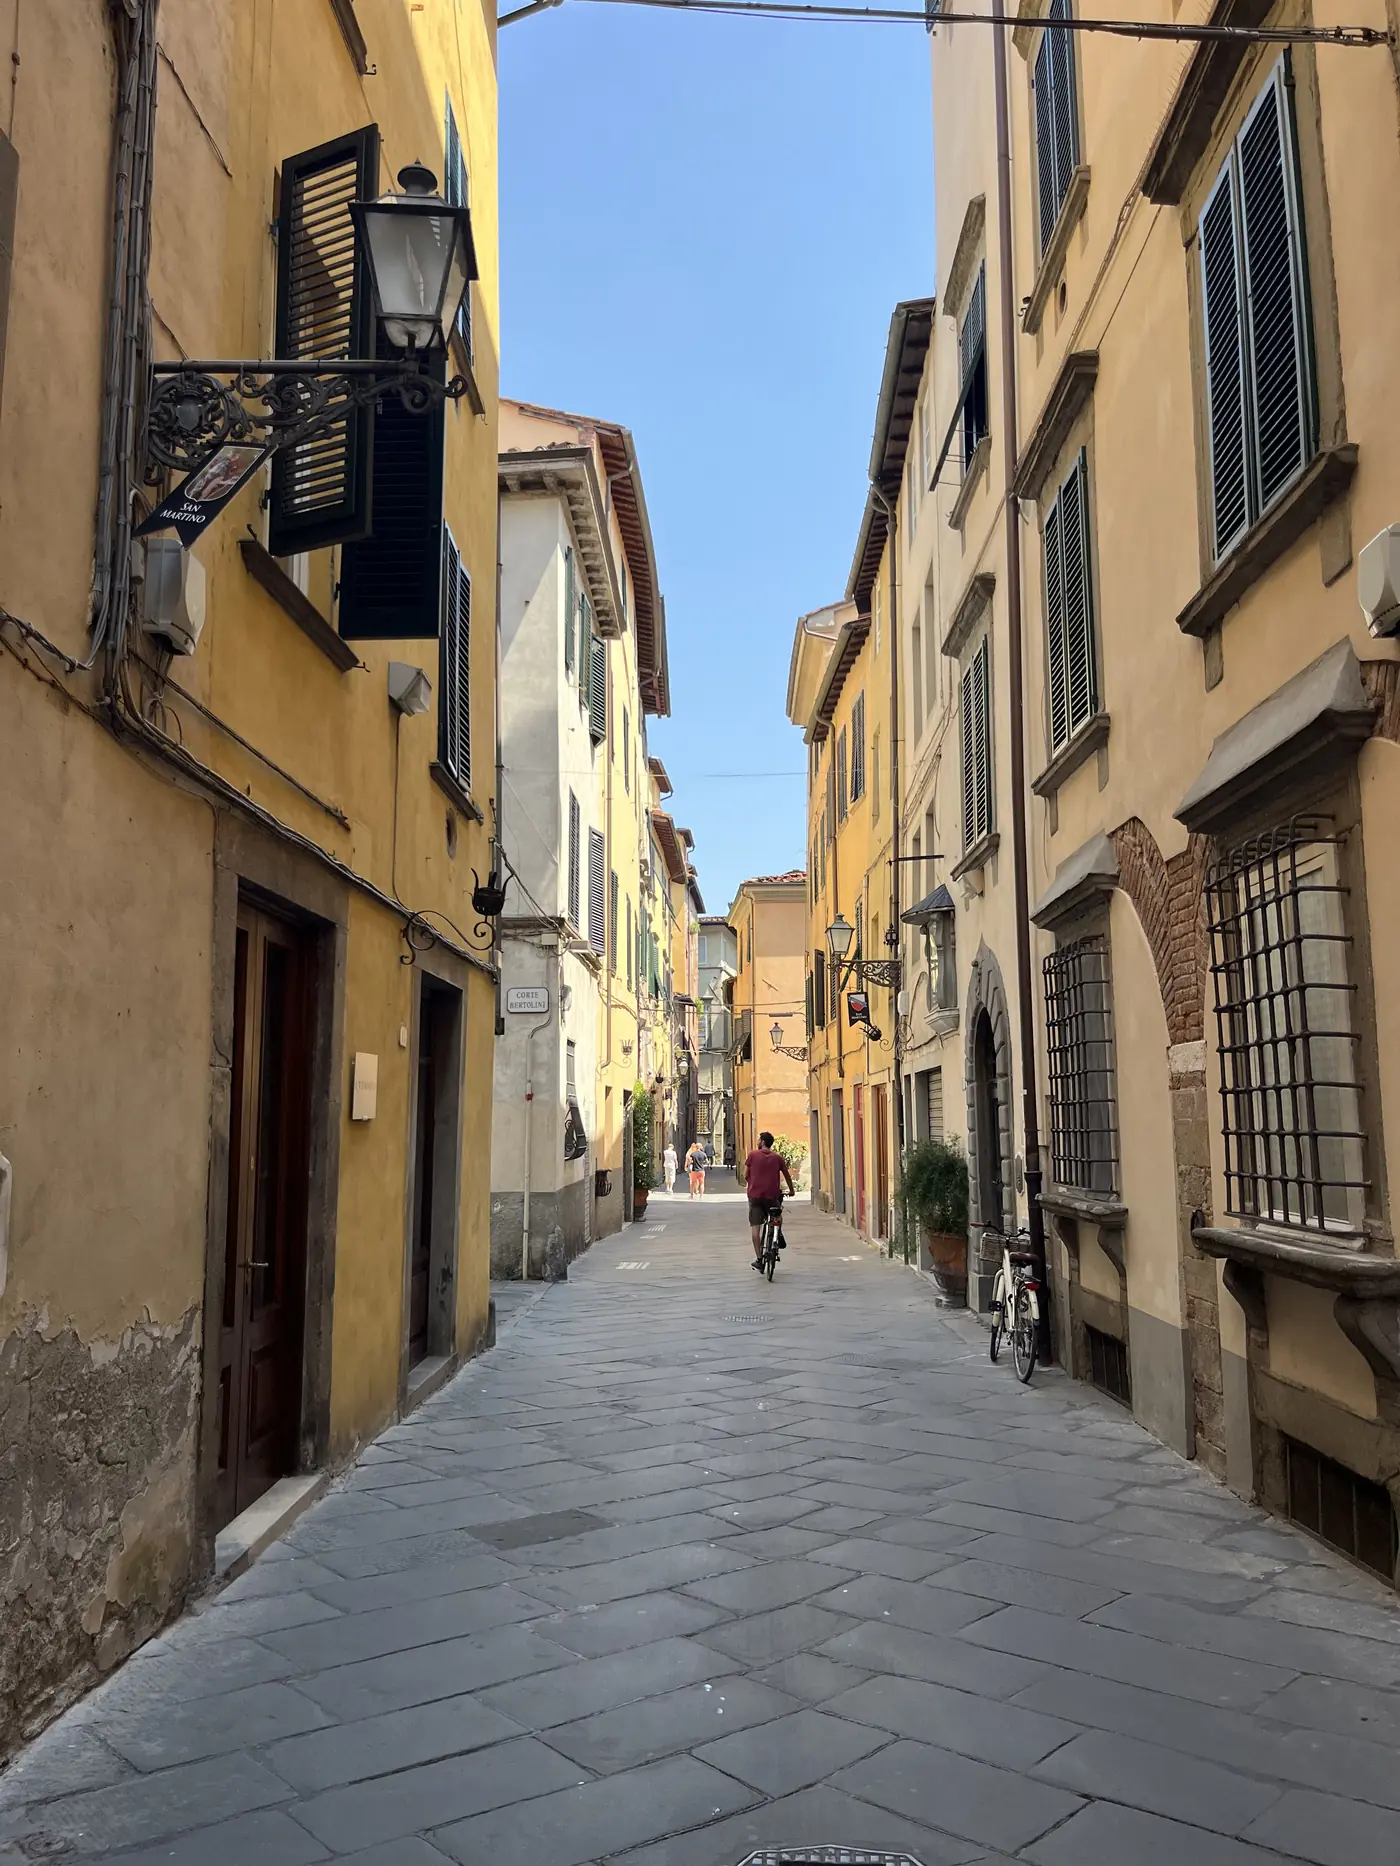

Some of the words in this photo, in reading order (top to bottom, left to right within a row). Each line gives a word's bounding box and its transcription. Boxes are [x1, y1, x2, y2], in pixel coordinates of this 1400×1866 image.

[180, 502, 202, 512] SAN
[160, 509, 206, 523] MARTINO
[510, 1001, 546, 1009] BERTOLINI
